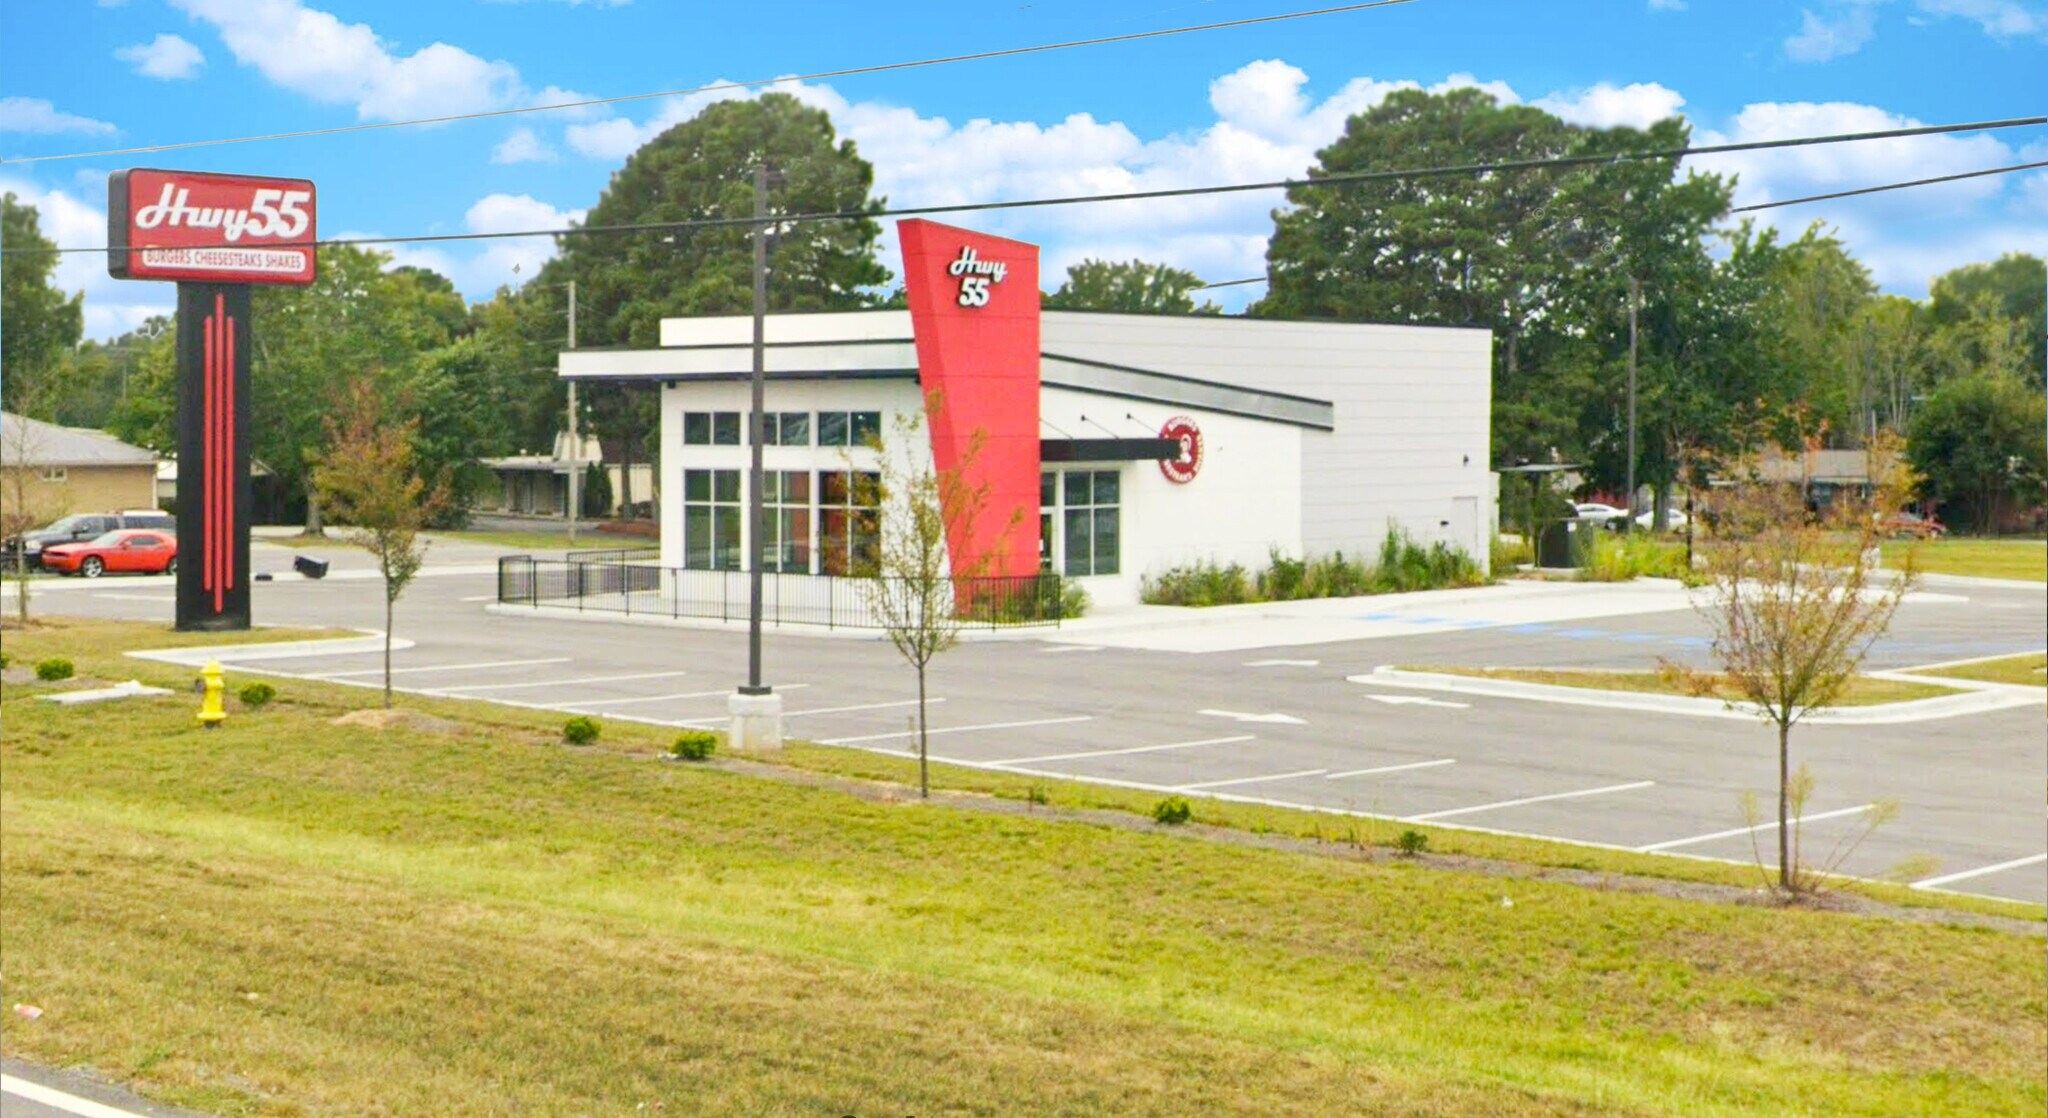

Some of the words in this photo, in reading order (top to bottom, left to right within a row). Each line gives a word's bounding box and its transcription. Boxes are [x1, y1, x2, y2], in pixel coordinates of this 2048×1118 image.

[146, 248, 191, 264] BURGERS
[194, 250, 262, 267] CHEESESTEAKS
[265, 254, 301, 269] SHAKES
[949, 245, 1008, 283] Hwy
[959, 276, 990, 307] 55
